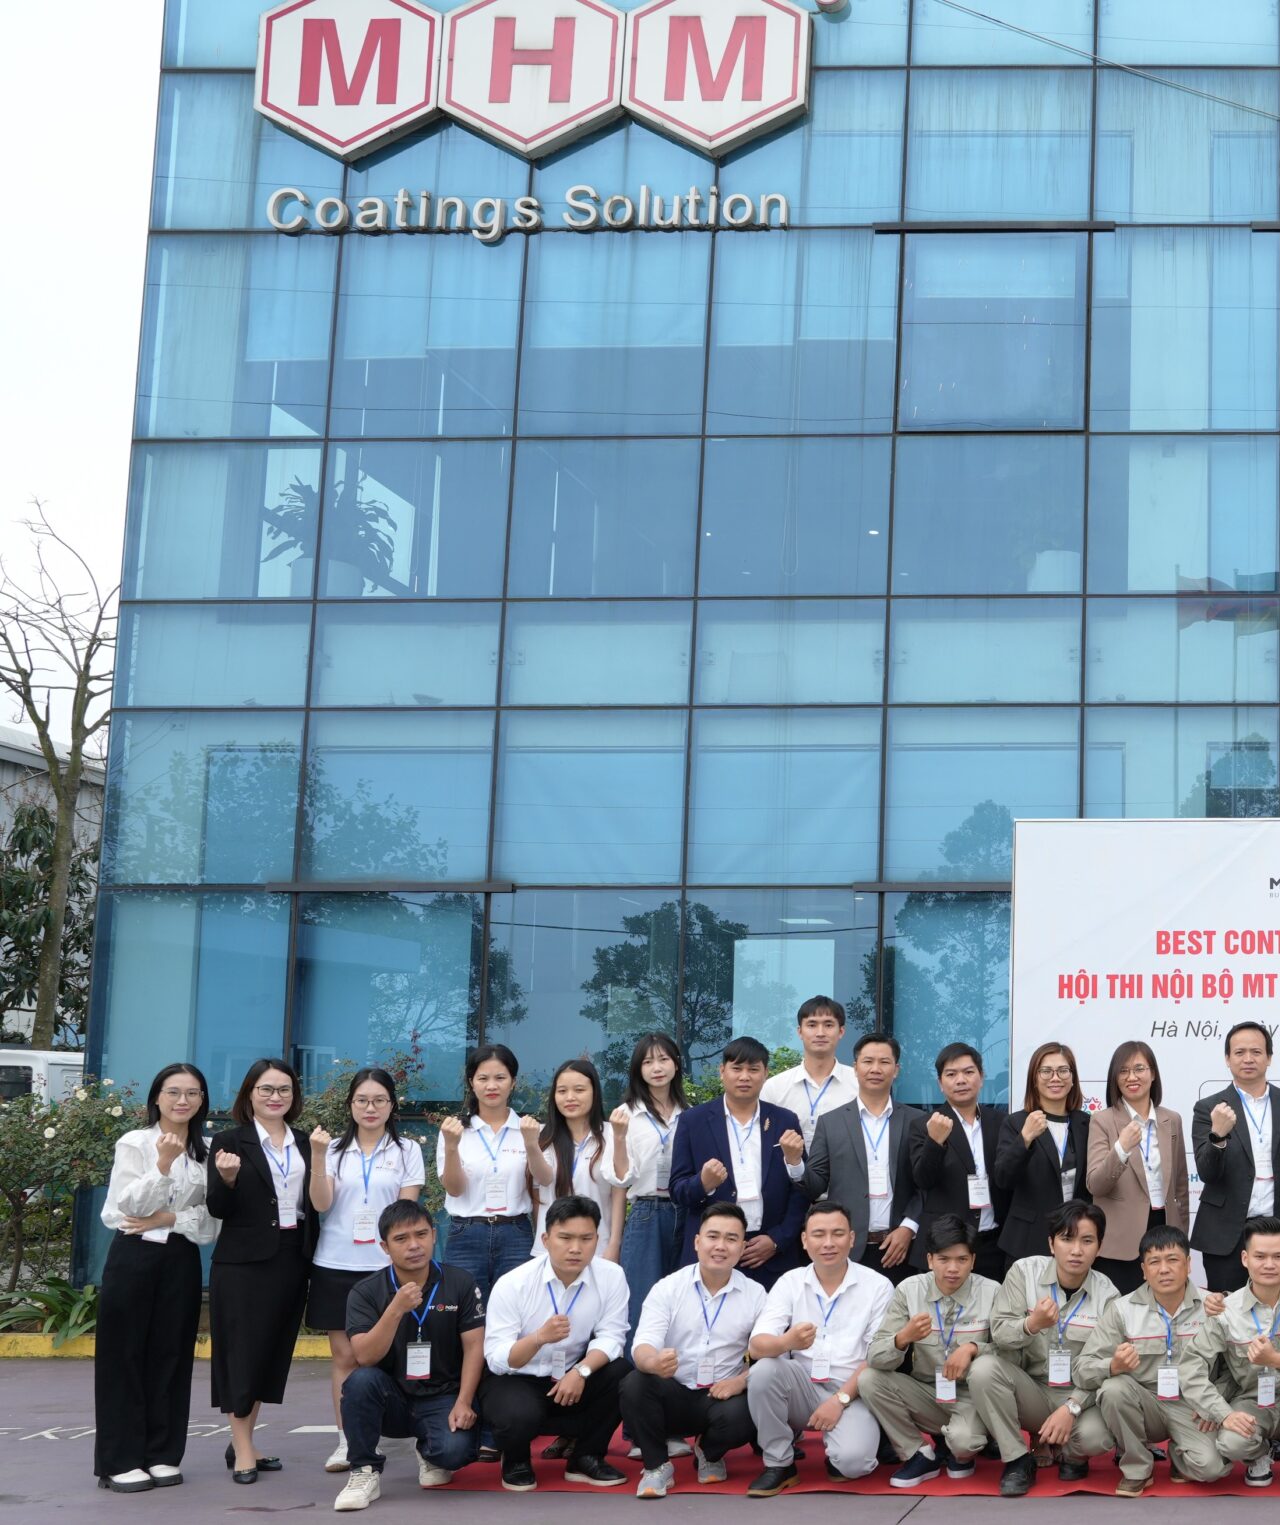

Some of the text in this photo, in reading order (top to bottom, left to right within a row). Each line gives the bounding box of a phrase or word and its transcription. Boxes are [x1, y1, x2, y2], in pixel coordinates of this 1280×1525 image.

[266, 184, 789, 240] Coatings Solution
[1156, 930, 1216, 955] BEST
[1058, 968, 1098, 1005] HỘI
[1106, 974, 1143, 999] THI
[1151, 968, 1193, 1004] NỘI
[1202, 968, 1234, 1004] BỘ
[1242, 973, 1278, 998] MT
[1150, 1020, 1178, 1038] Hà
[1185, 1020, 1222, 1040] Nội,
